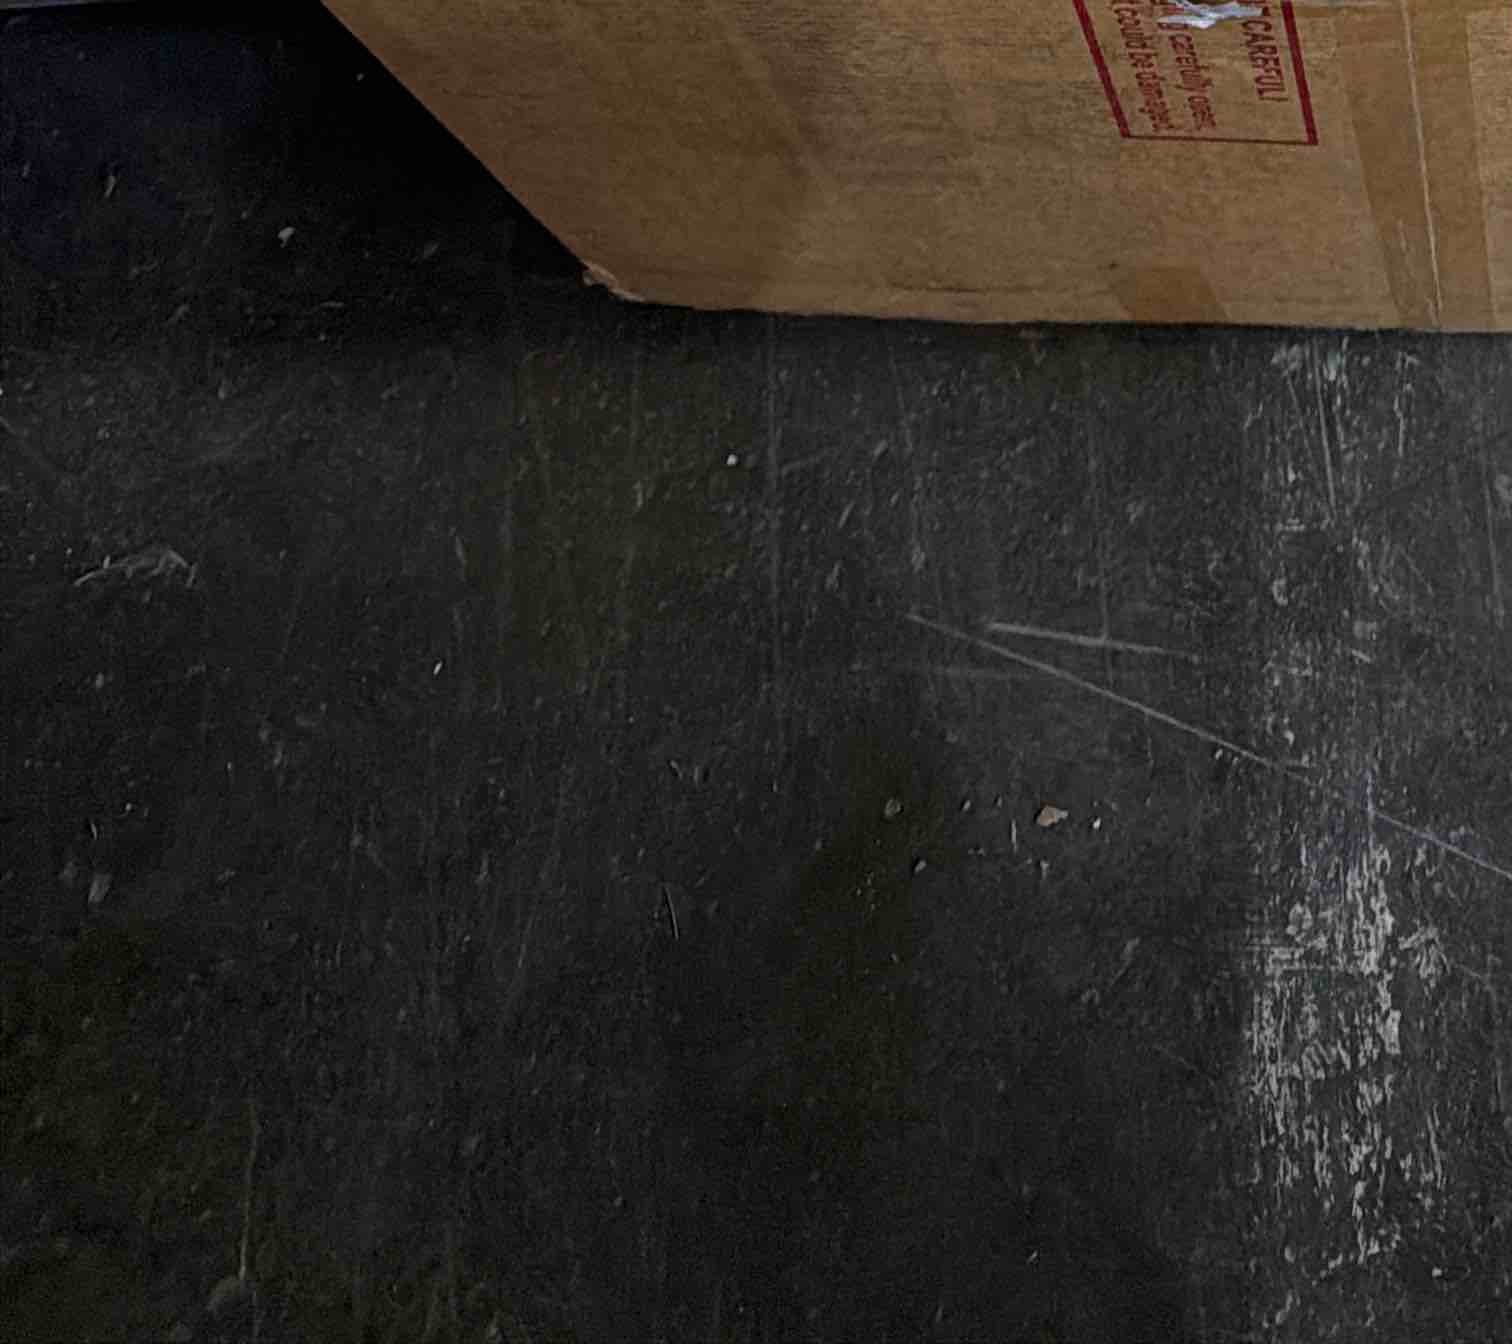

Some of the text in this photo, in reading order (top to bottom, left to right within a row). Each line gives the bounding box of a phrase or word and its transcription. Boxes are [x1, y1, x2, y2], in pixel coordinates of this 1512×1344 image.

[1113, 8, 1157, 50] could
[1128, 51, 1159, 69] be
[1169, 33, 1216, 92] carefully
[1241, 20, 1289, 102] CAREFUL!
